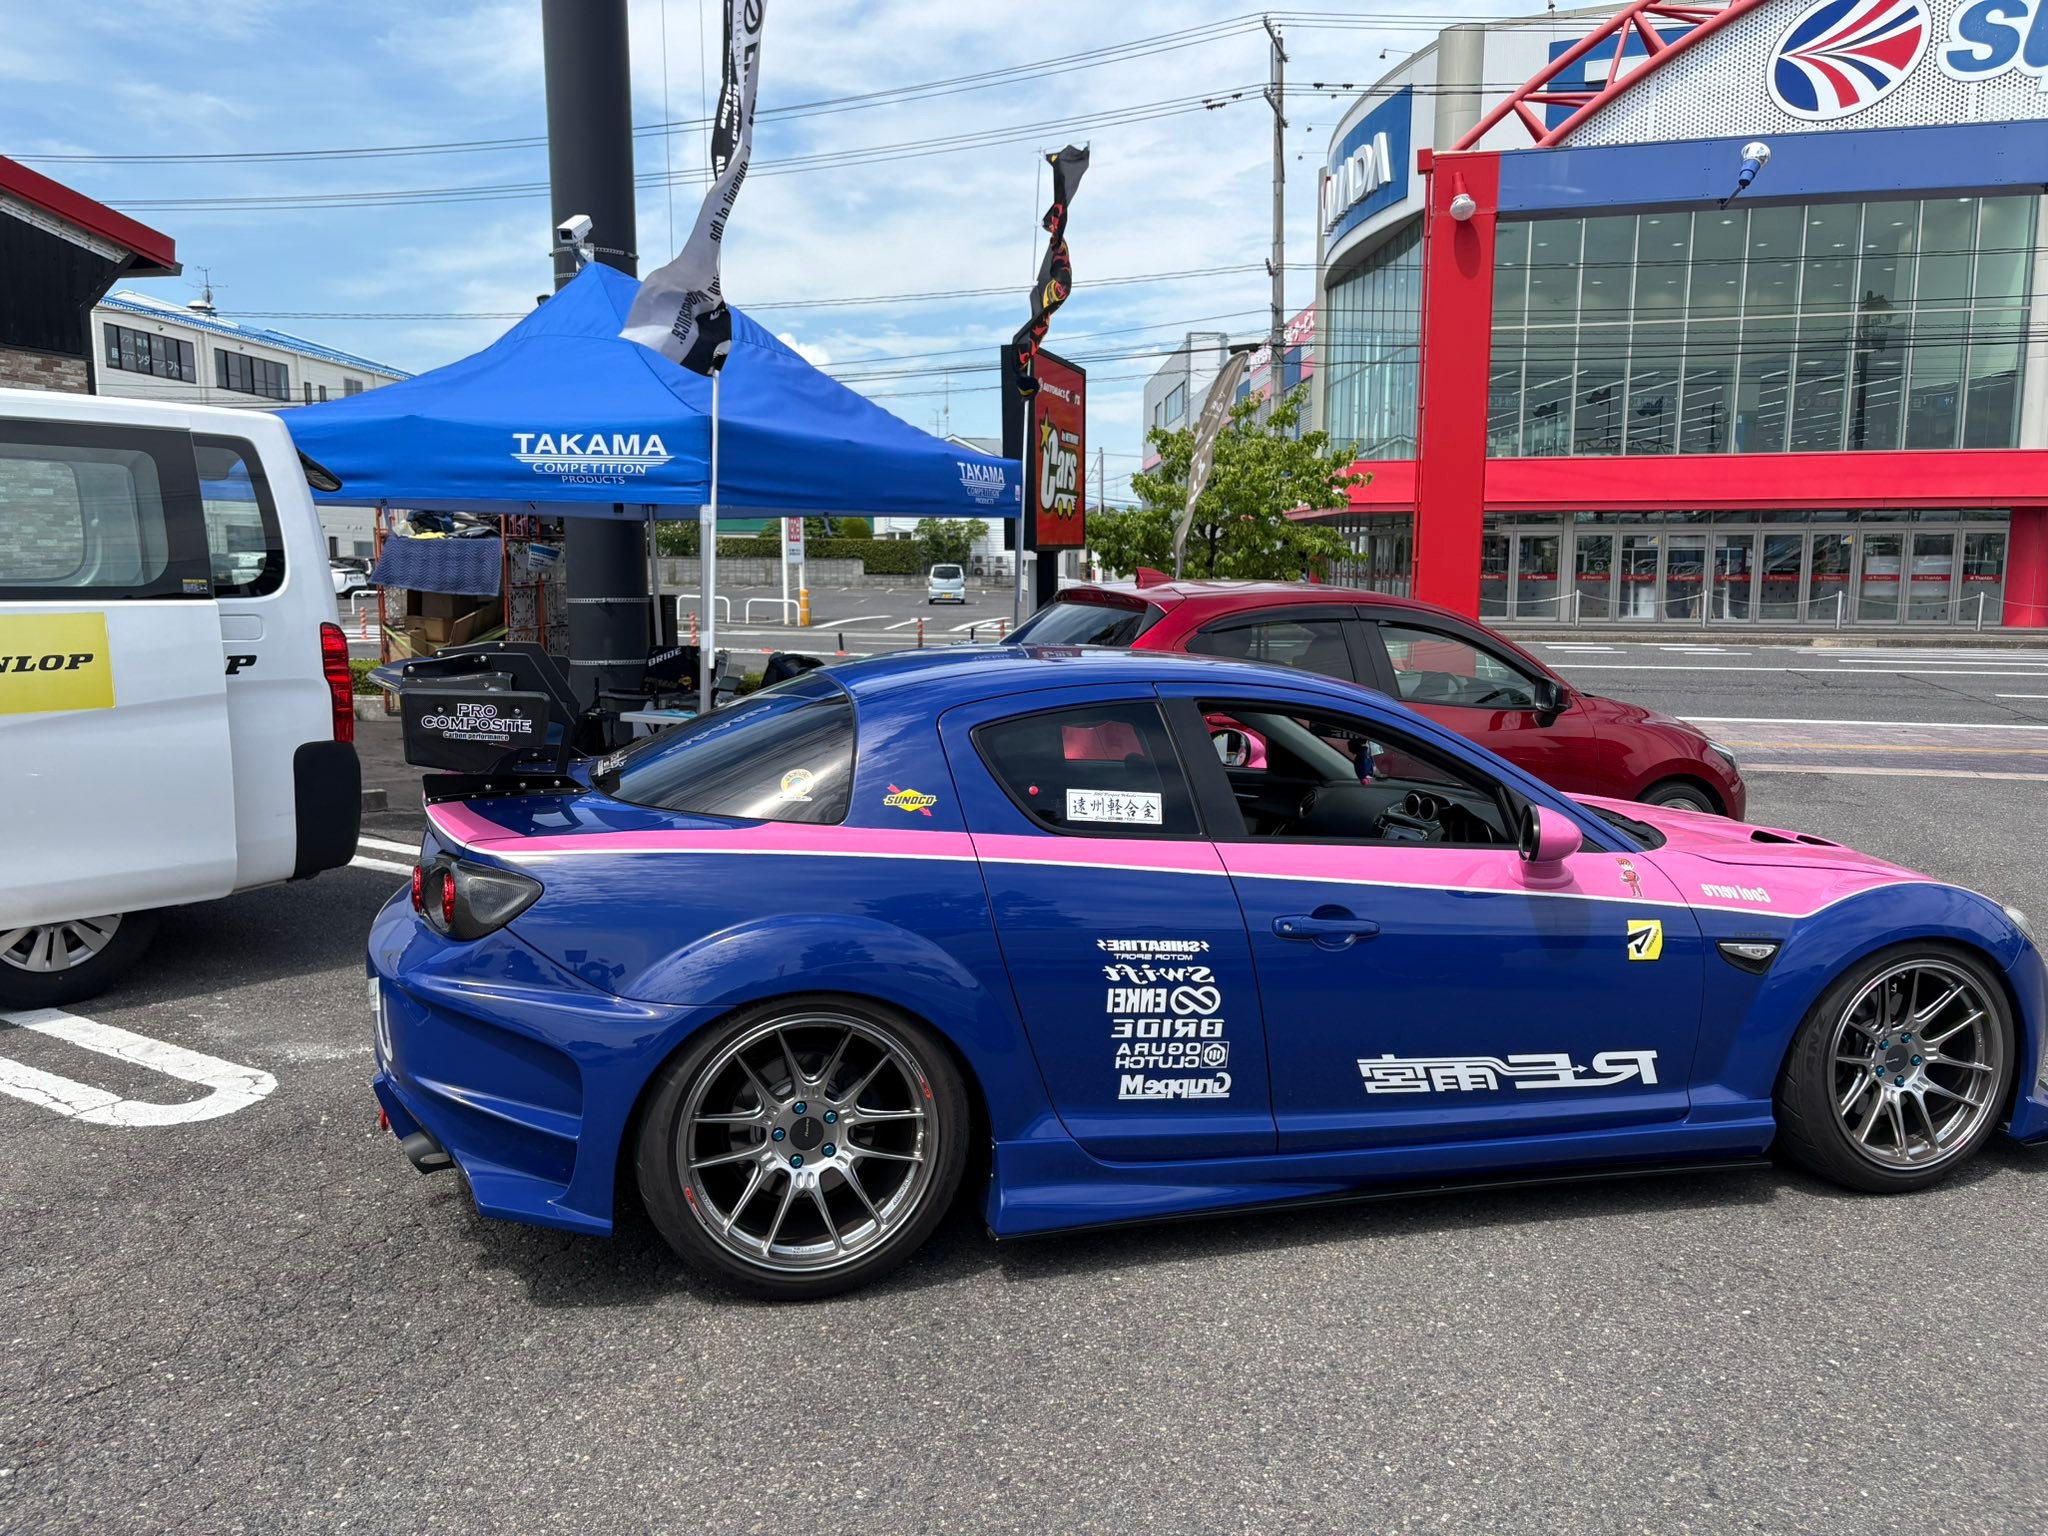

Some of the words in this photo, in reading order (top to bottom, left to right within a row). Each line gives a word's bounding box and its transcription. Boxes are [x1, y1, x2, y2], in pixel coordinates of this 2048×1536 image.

[512, 433, 668, 455] TAKAMA
[533, 463, 647, 474] COMPETITION
[957, 462, 1005, 484] TAKAMA
[1041, 428, 1077, 510] Cars
[561, 475, 625, 485] PRODUCTS
[966, 487, 1000, 498] COMPETITION
[648, 647, 683, 667] BRIDE
[457, 703, 498, 718] PRO
[421, 715, 532, 733] COMPOSITE
[443, 731, 467, 740] Carbon
[467, 732, 509, 742] performance
[885, 795, 935, 805] SUNOCO
[1072, 796, 1157, 819] 遠州軽合金
